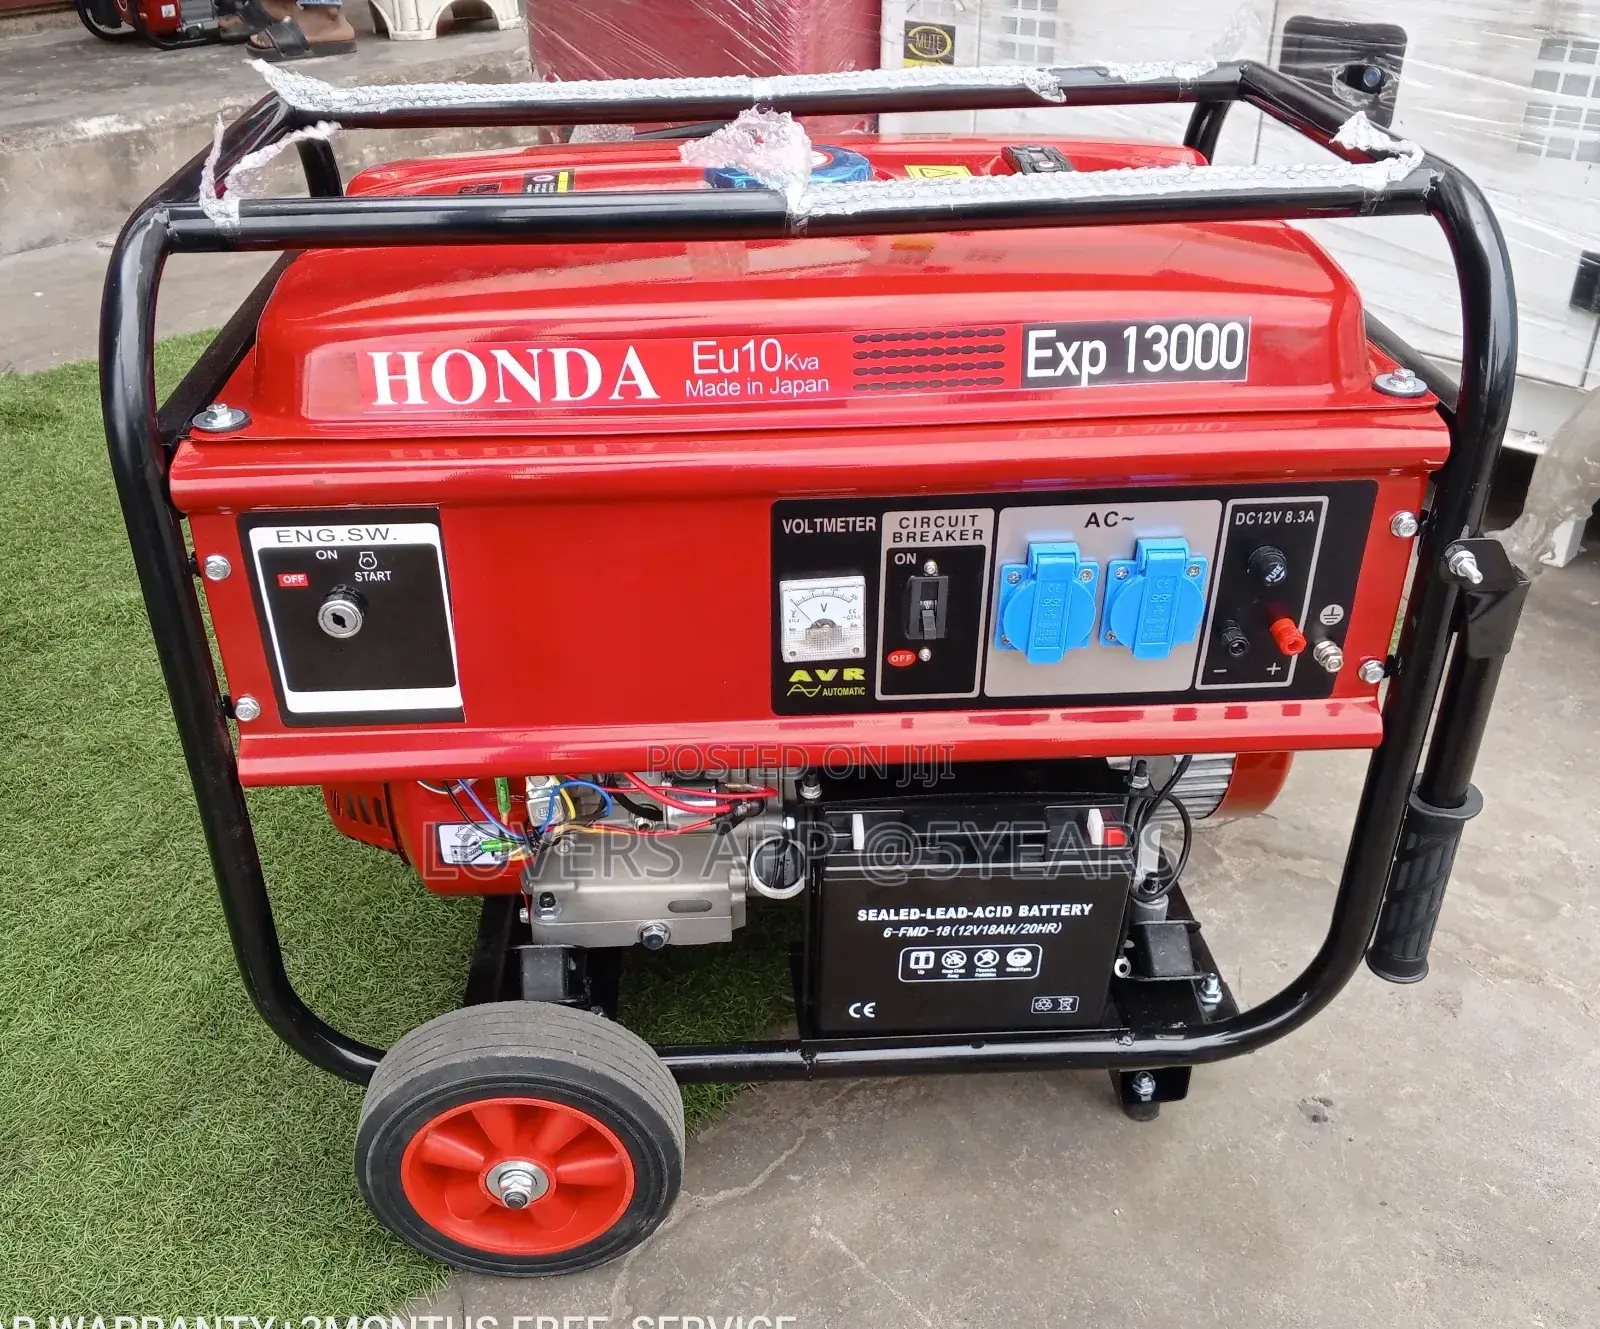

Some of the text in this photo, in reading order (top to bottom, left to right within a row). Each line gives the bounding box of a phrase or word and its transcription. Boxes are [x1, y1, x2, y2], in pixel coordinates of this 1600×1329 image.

[916, 32, 943, 51] MUTE
[1027, 321, 1245, 387] Exp 13000
[366, 344, 661, 406] HONDA
[685, 375, 829, 397] Made in Japan
[782, 516, 877, 534] VOLTMETER
[899, 514, 979, 530] CIRCUIT
[1235, 509, 1315, 525] DC12V 8.3A
[276, 526, 398, 543] ENG.SW.
[892, 529, 984, 543] BREAKER
[316, 549, 338, 561] ON
[894, 552, 917, 566] ON
[282, 574, 305, 584] OFF
[354, 570, 392, 582] START
[1265, 563, 1284, 583] FUSE
[820, 602, 828, 613] V
[891, 654, 913, 664] OFF
[788, 667, 865, 683] AVR
[822, 686, 866, 697] AUTOMATIC
[857, 903, 1093, 922] SEALED-LEAD-ACID BATTERY
[848, 1002, 876, 1018] CE
